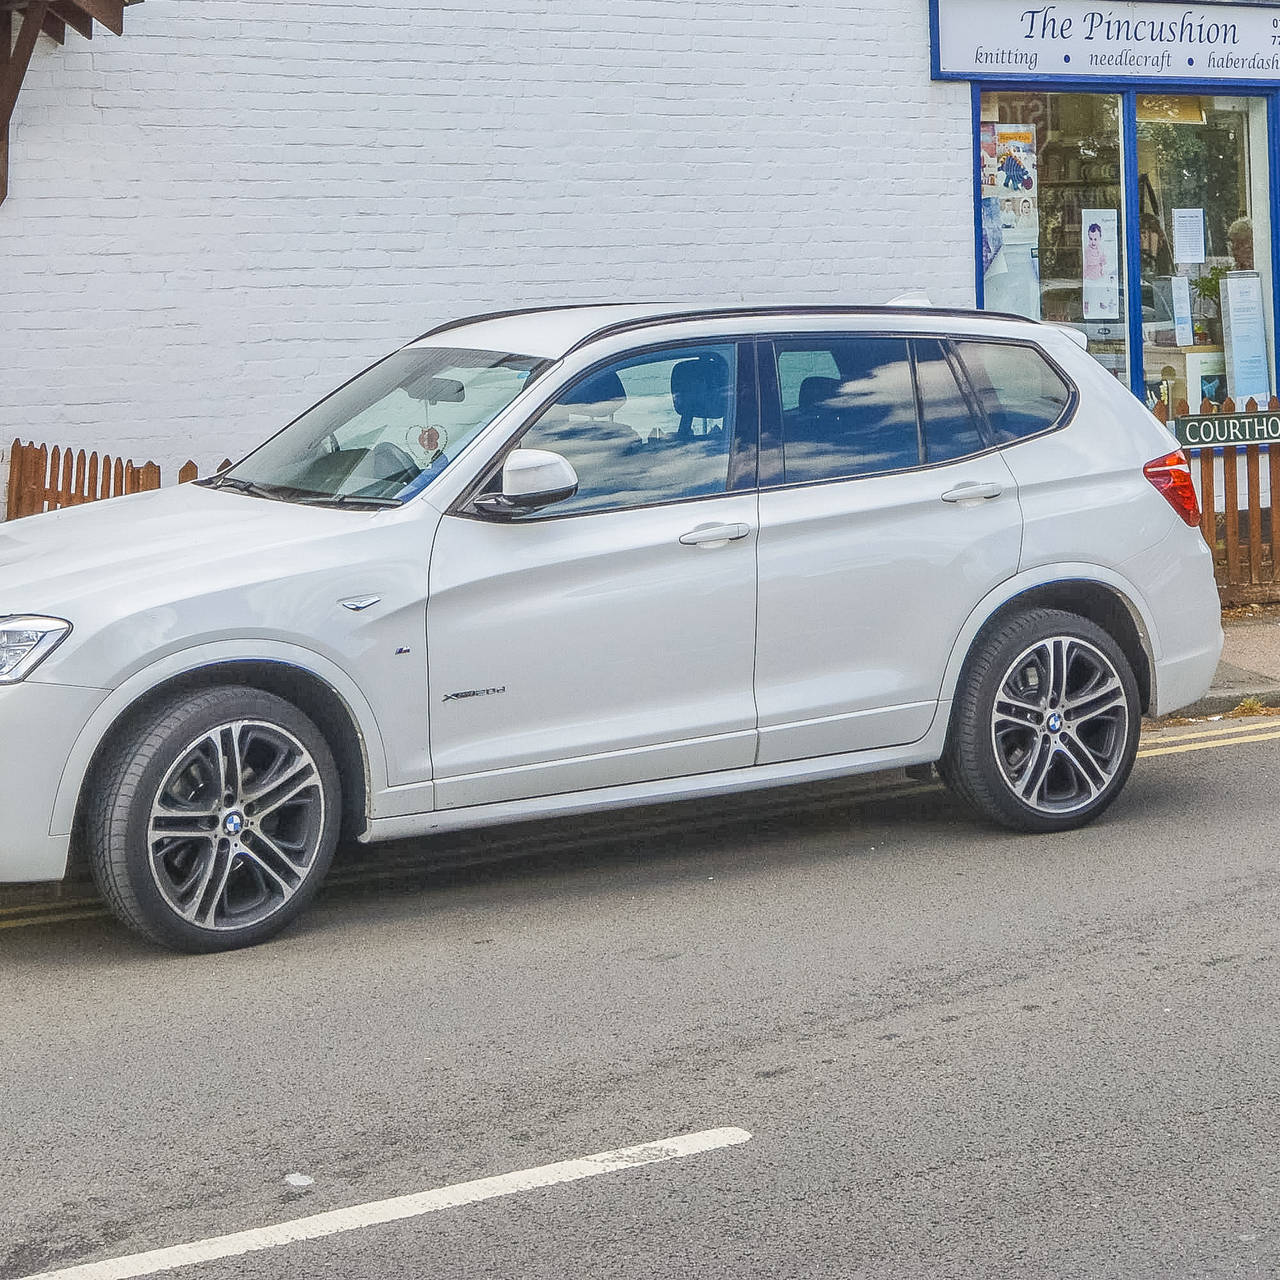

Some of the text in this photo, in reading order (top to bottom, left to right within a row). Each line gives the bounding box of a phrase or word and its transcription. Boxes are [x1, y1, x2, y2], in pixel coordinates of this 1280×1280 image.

[1020, 6, 1239, 45] The Pincushion
[975, 46, 1038, 70] knitting
[1089, 49, 1172, 72] needlecraft
